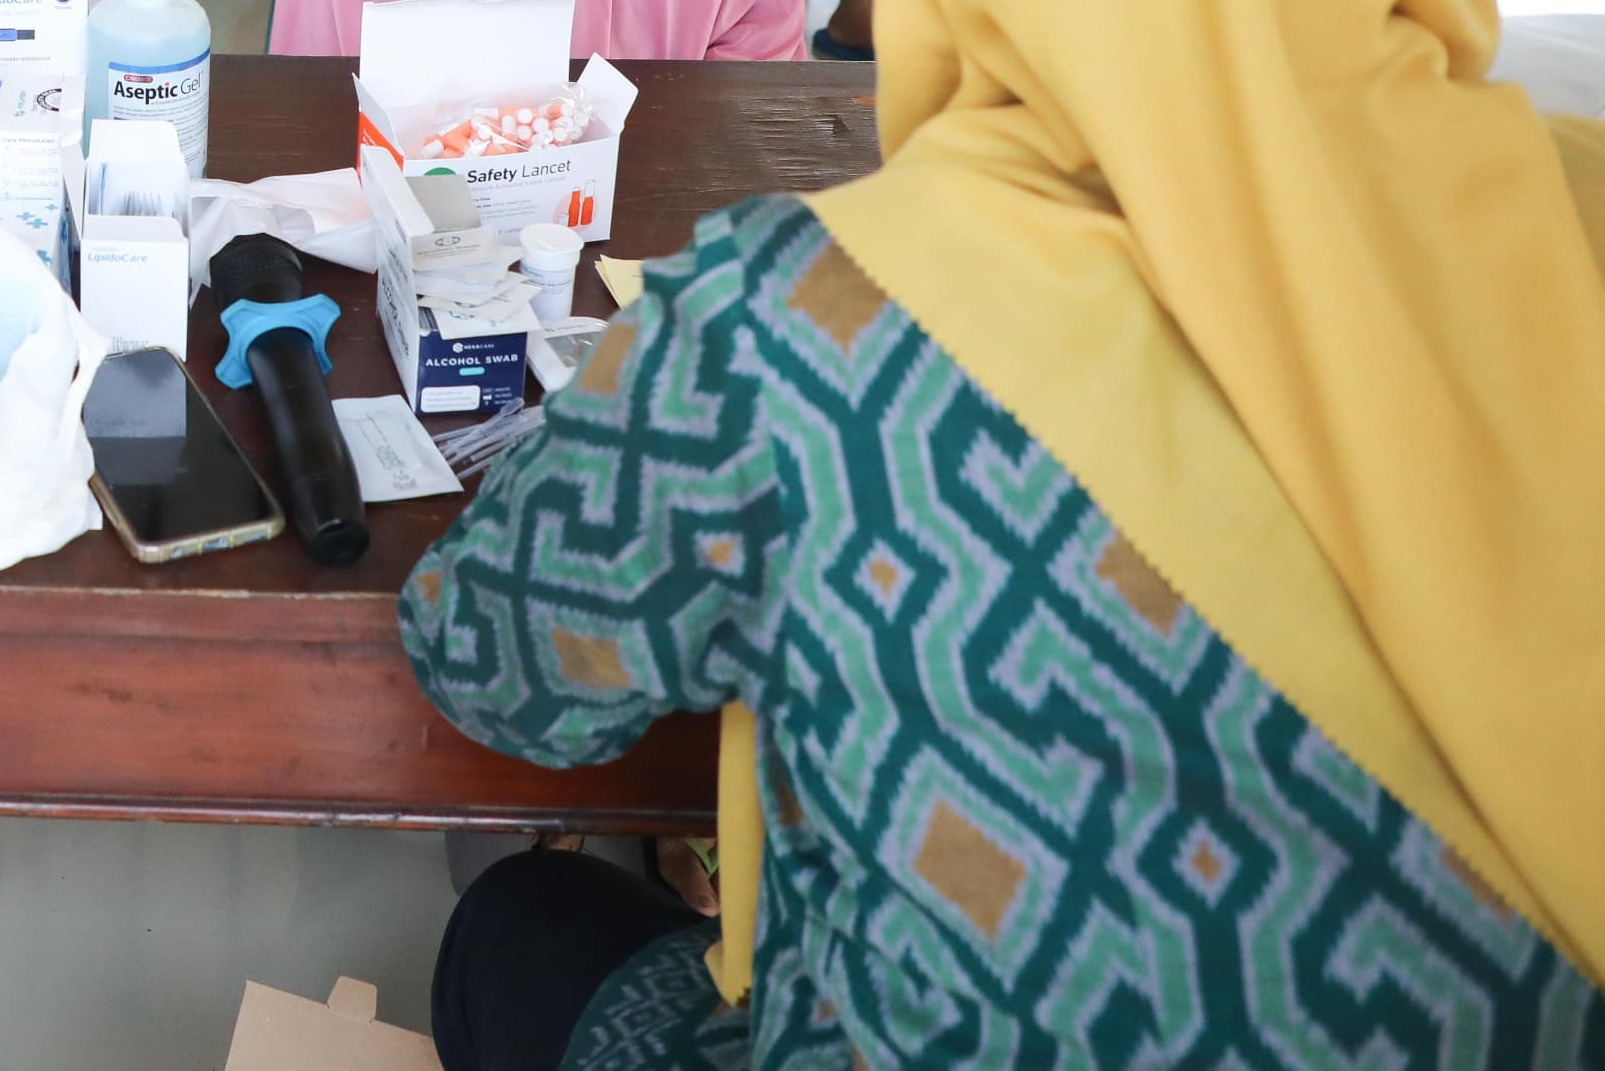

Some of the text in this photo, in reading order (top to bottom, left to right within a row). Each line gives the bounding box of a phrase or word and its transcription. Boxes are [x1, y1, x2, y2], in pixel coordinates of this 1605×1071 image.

[114, 72, 201, 105] Aseptic Gel
[467, 159, 571, 183] Safety Lancet
[88, 253, 147, 264] LipidoCare
[425, 354, 518, 367] ALCOHOL SWAB
